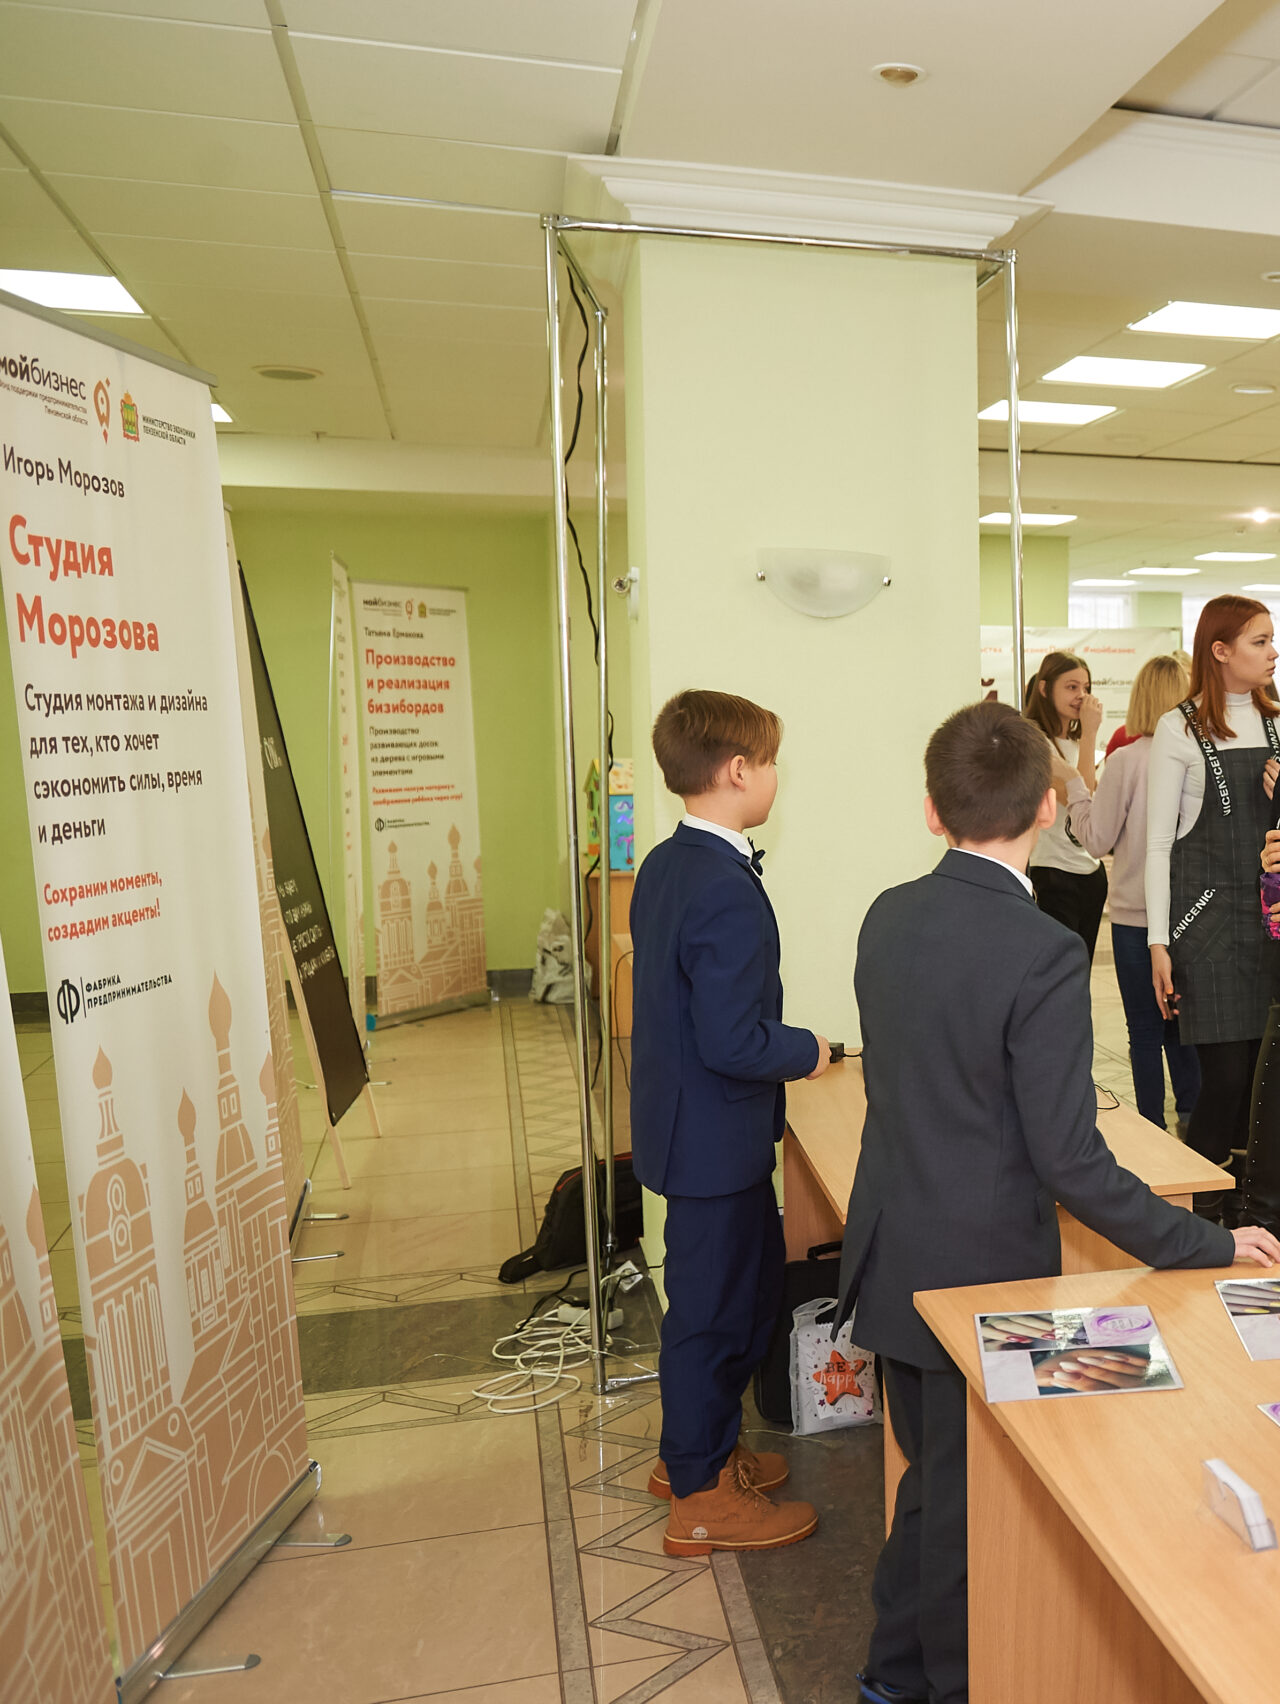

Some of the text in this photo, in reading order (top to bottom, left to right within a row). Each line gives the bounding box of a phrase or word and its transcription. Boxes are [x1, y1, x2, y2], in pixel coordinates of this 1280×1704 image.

[0, 354, 87, 400] мойбизнес
[3, 443, 126, 498] Игорь Морозов
[9, 513, 115, 582] Студия
[16, 592, 160, 659] Морозова
[365, 648, 456, 669] Производство
[25, 683, 208, 718] Студия монтажа и дизайна
[366, 678, 450, 694] и реализация
[367, 698, 444, 718] бизибордов
[29, 731, 160, 759] для тех, кто хочет
[369, 726, 420, 736] Производство
[370, 741, 439, 751] развивающих досок
[380, 755, 406, 764] дерева
[33, 768, 203, 800] сэкономить силы, время
[38, 817, 106, 846] и деньги
[43, 870, 162, 907] Сохраним моменты,
[47, 898, 161, 942] создадим акценты!
[85, 974, 121, 993] ФАБРИКА
[87, 974, 173, 1009] ПРЕДПРИНИМАТЕЛЬСТВА
[825, 1362, 846, 1373] BE
